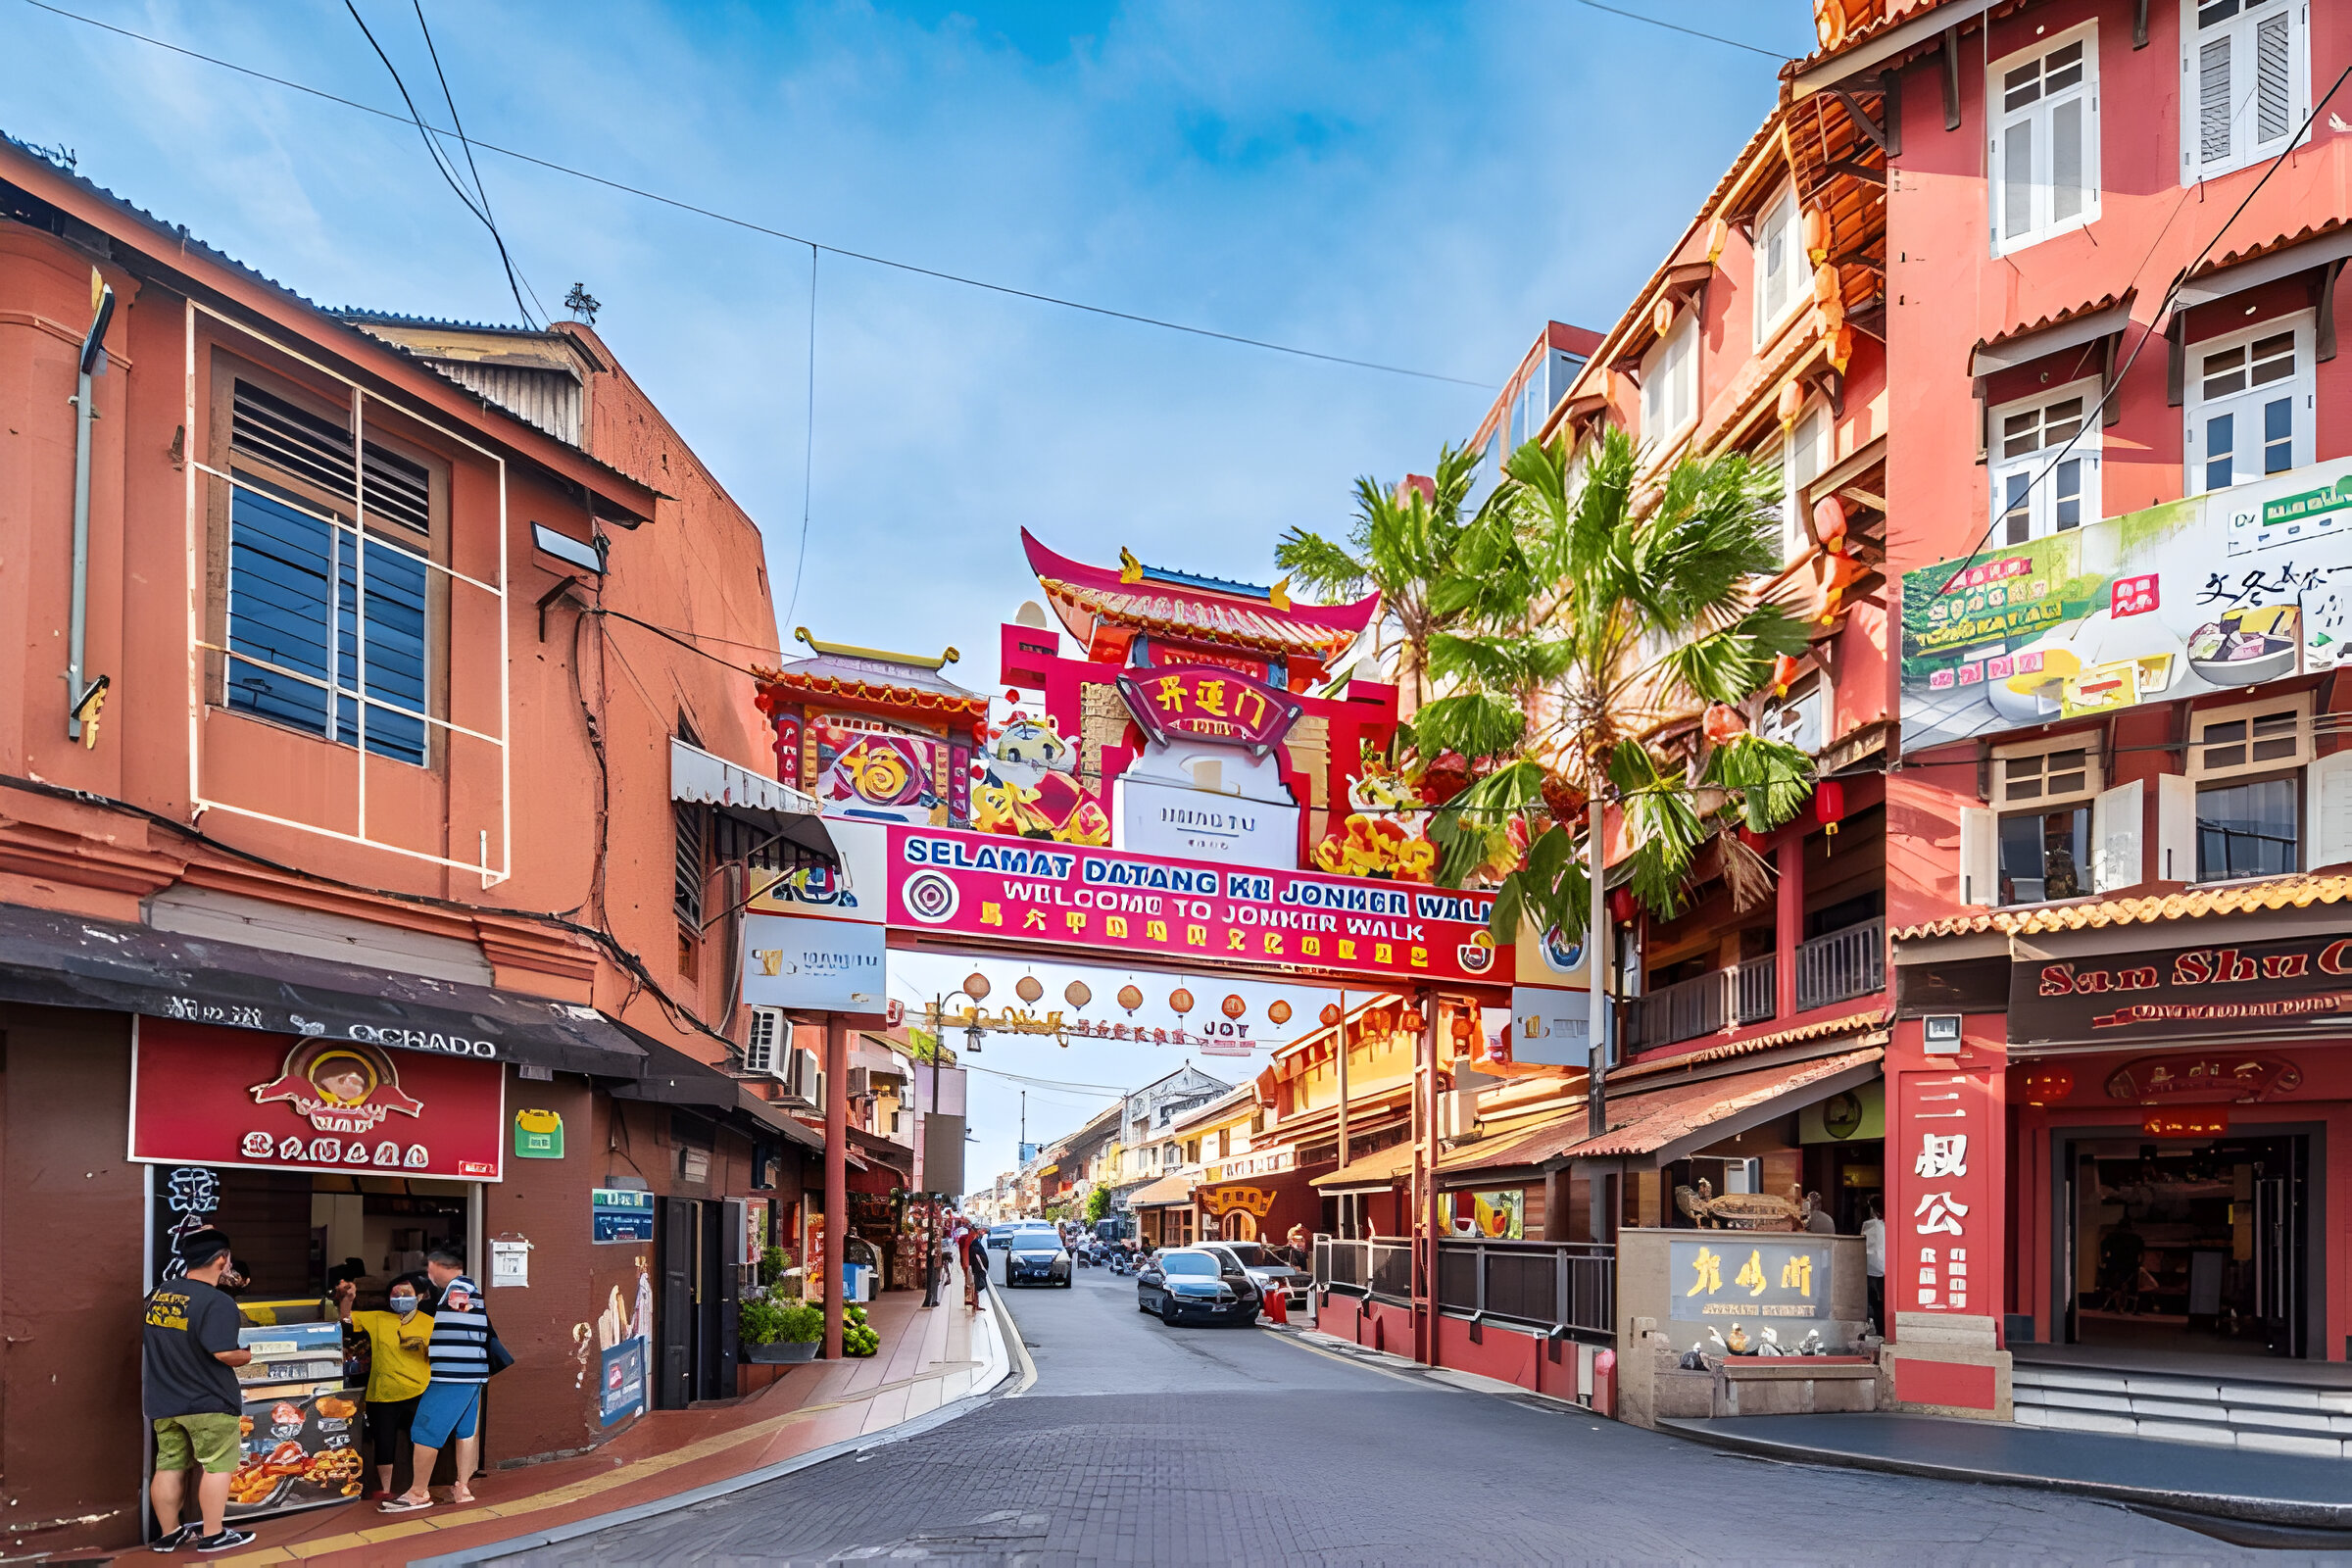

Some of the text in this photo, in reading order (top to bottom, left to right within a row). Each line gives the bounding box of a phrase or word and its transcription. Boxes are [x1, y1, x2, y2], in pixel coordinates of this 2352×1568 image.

[904, 835, 1076, 880] SELAMAT
[1082, 855, 1220, 898] DATANG
[1279, 879, 1410, 918] JONKER
[1171, 899, 1212, 920] TO
[1346, 917, 1426, 942] WALK
[2038, 961, 2161, 997] San
[2171, 948, 2309, 986] Shu
[1913, 1075, 1970, 1237] 三叔公
